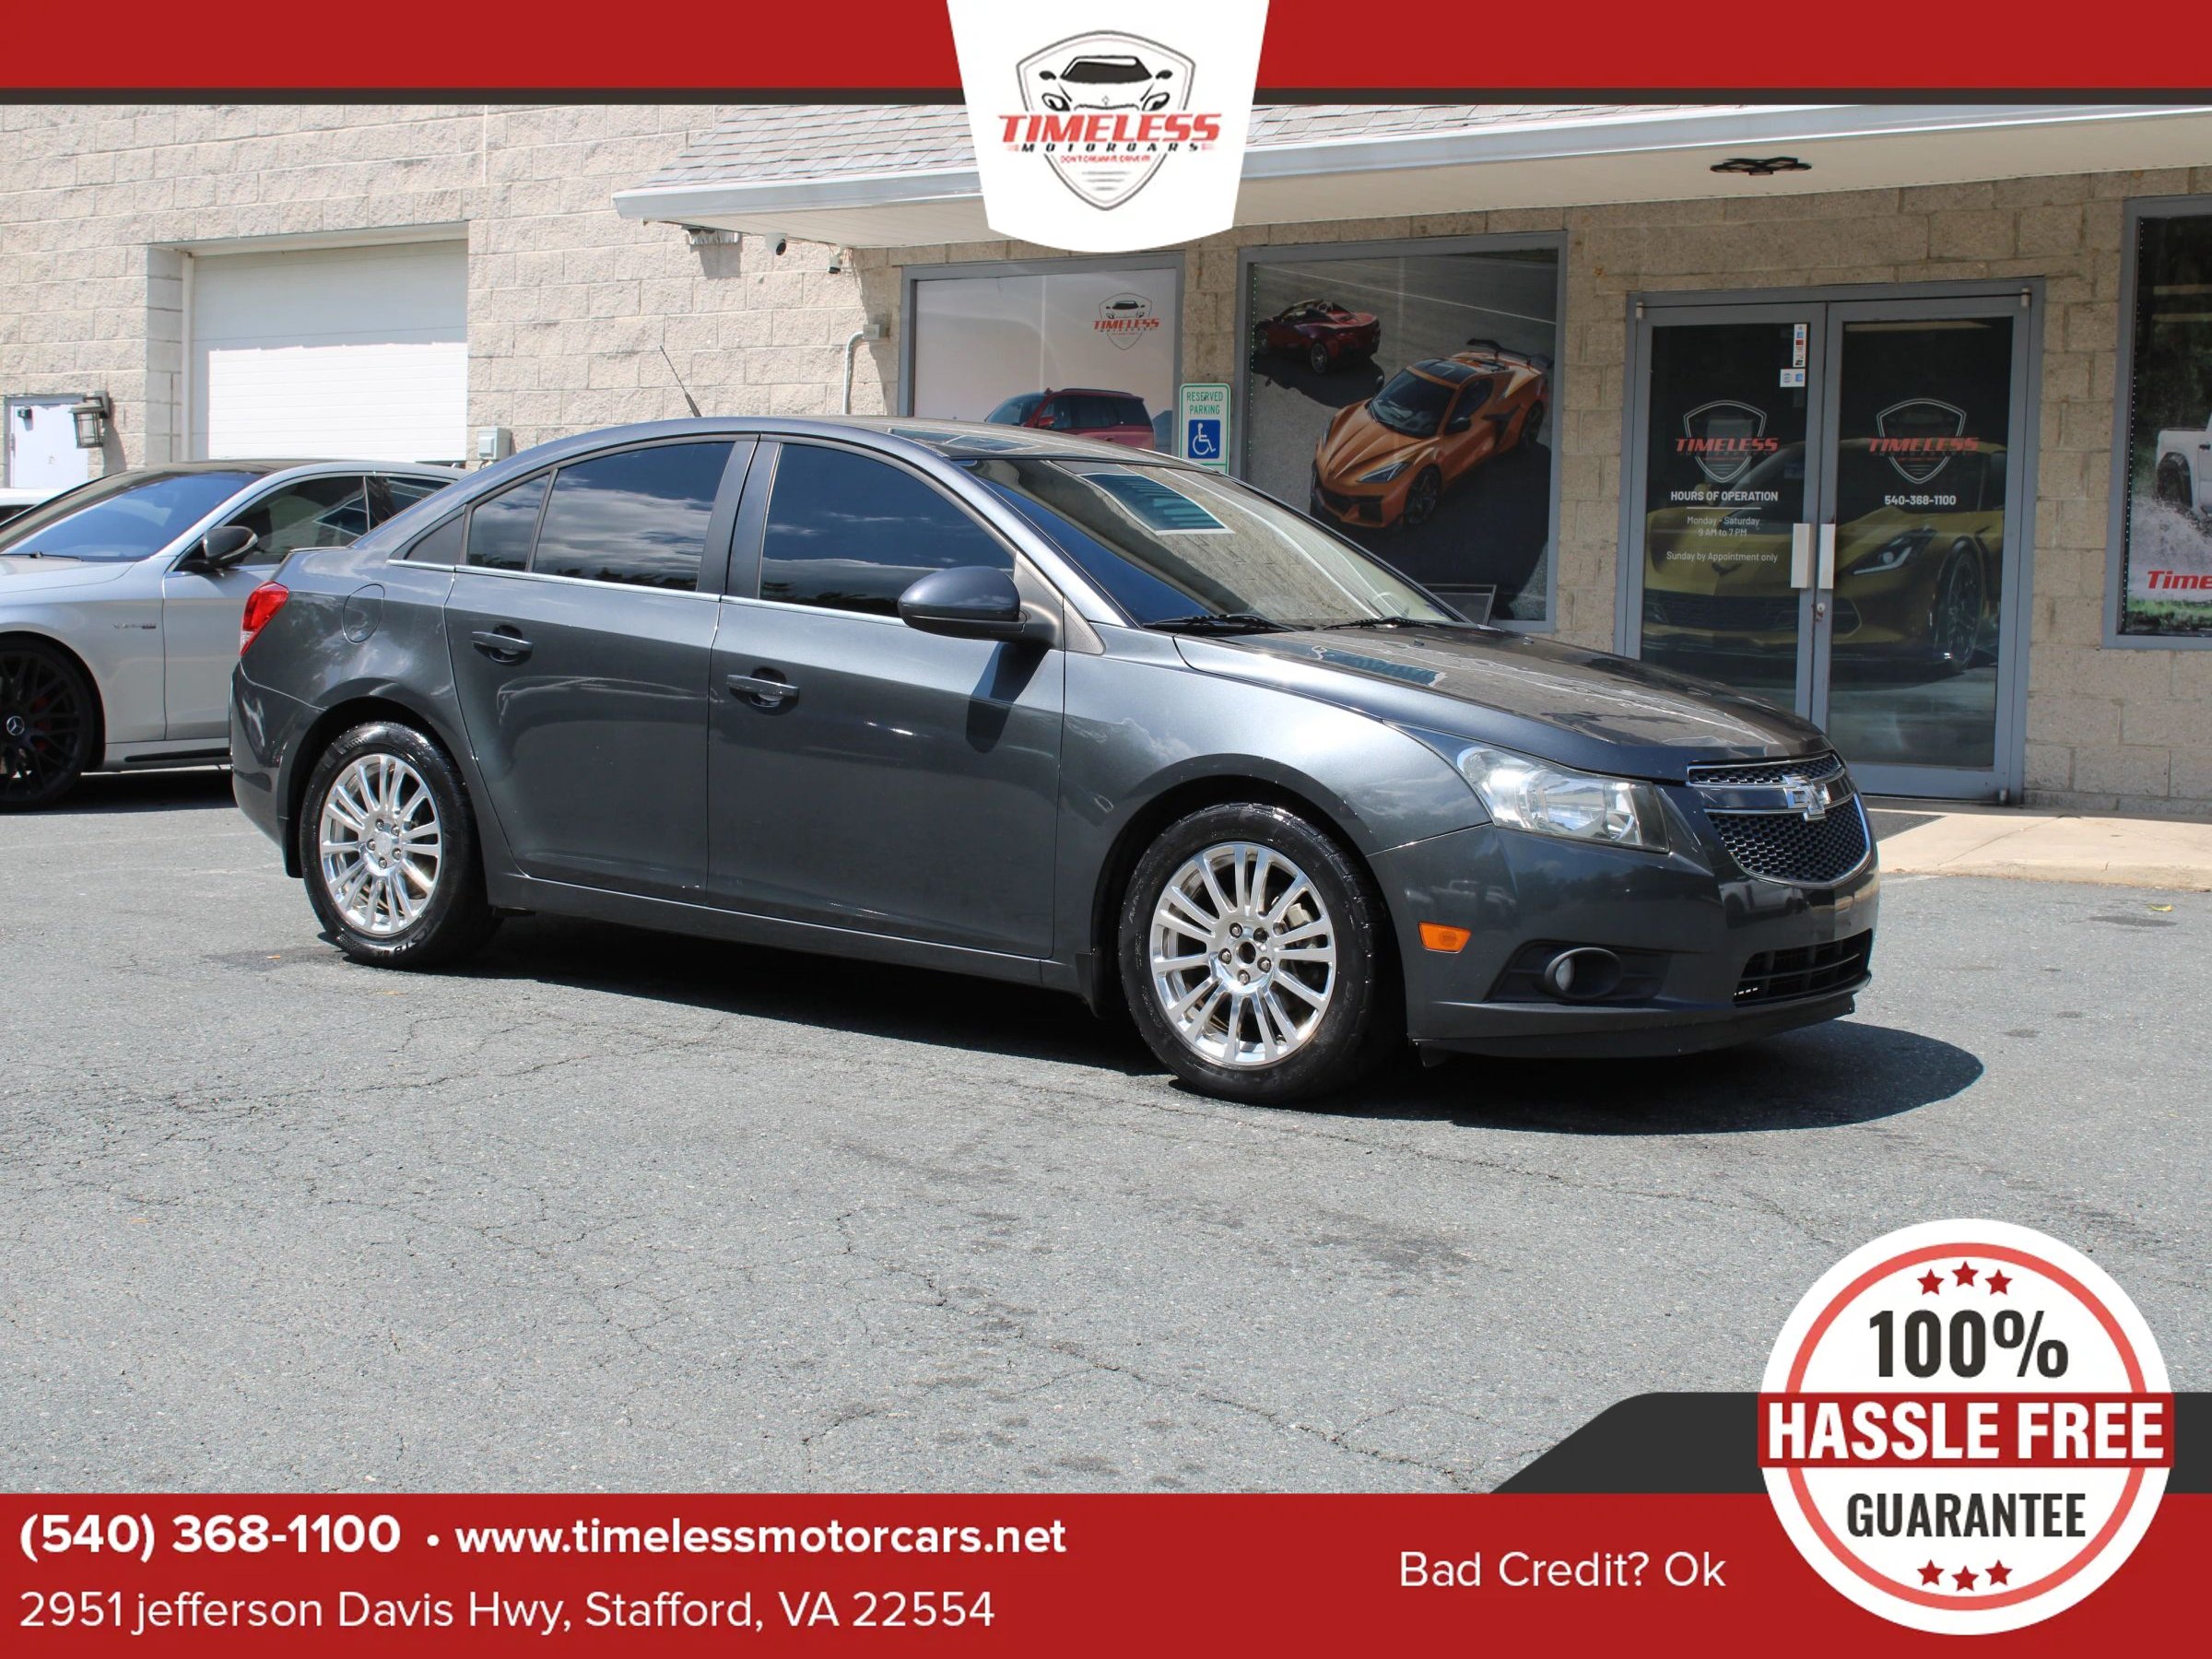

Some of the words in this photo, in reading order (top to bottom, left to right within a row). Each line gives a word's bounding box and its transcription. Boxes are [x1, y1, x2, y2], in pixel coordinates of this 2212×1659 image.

[1093, 318, 1159, 330] TIMELESS
[1186, 391, 1224, 402] RESERVED
[1189, 405, 1221, 415] PARKING
[1676, 438, 1779, 452] TIMELESS
[1869, 438, 1979, 452] TIMELESS
[1670, 491, 1704, 501] HOURS
[1706, 491, 1720, 501] OF
[1721, 491, 1779, 501] OPERATION
[1884, 495, 1957, 506] 540-368-1100
[1687, 516, 1717, 526] Monday
[1724, 516, 1760, 526] Saturday
[1698, 529, 1703, 537] 9
[1704, 529, 1718, 537] AM
[1718, 529, 1727, 537] to
[1728, 529, 1734, 537] 7
[1734, 529, 1747, 537] PM
[1666, 551, 1695, 561] Sunday
[1697, 552, 1706, 562] by
[1708, 552, 1759, 563] Appointment
[1760, 553, 1778, 563] only
